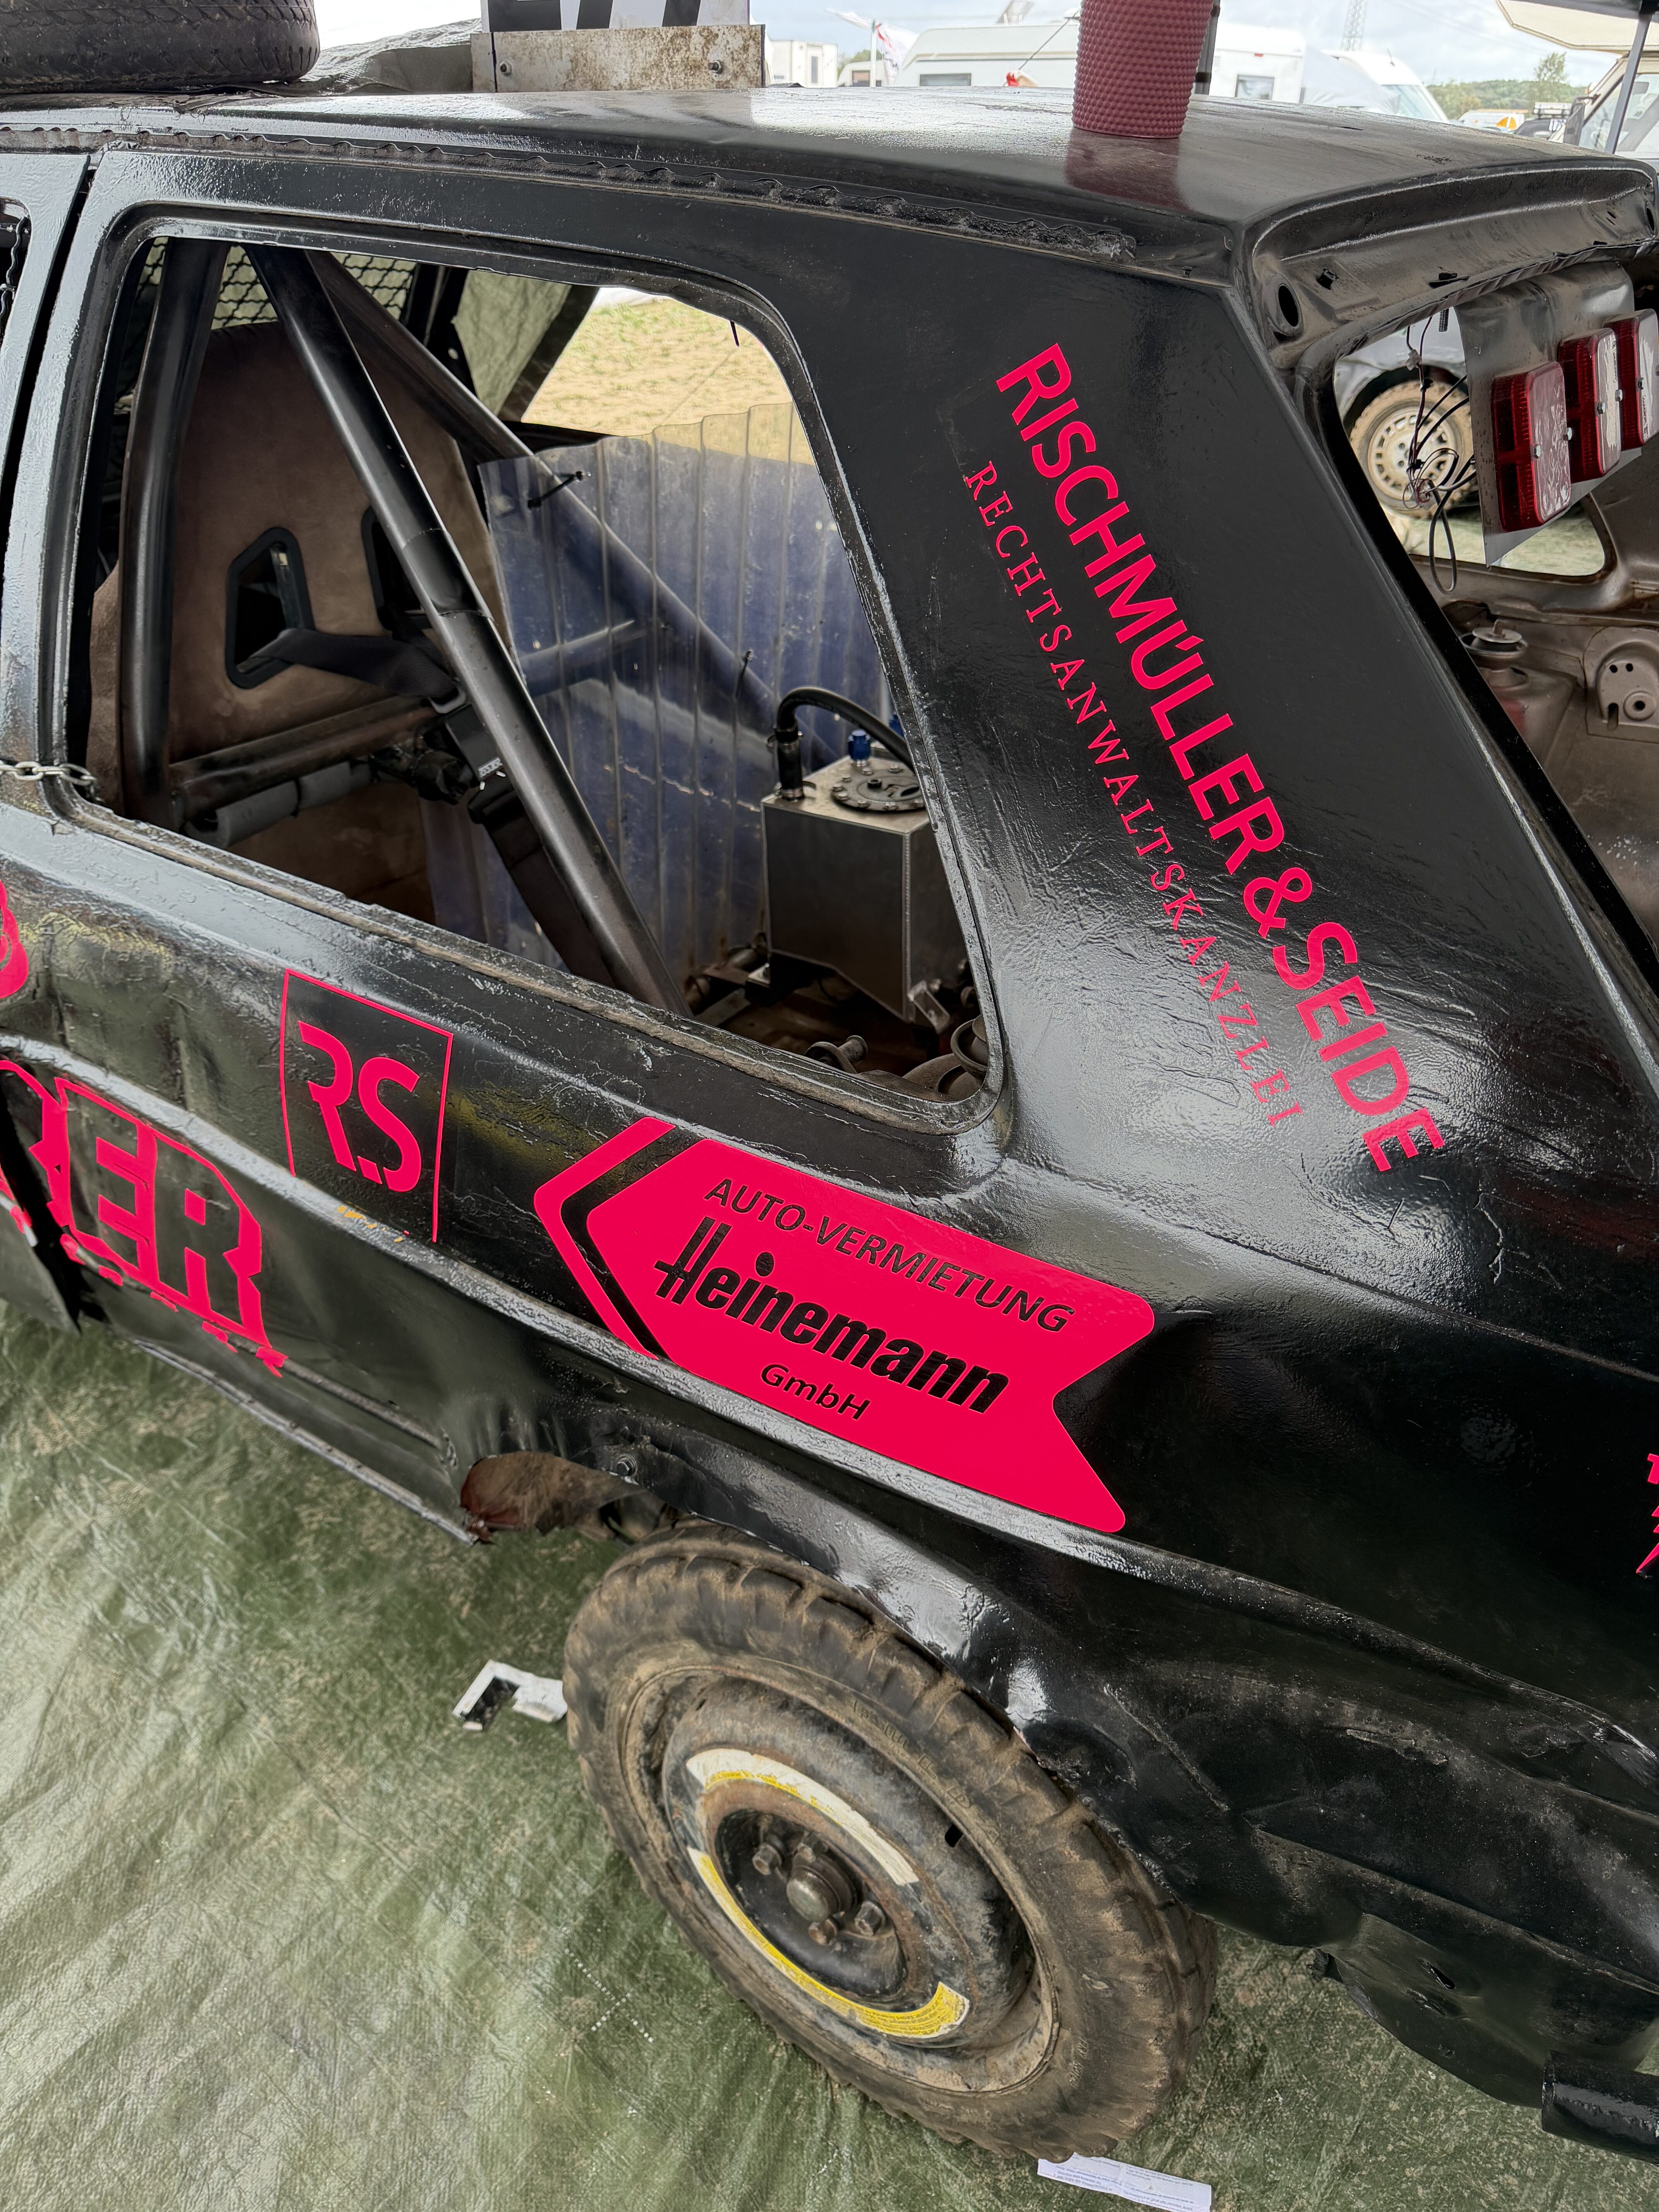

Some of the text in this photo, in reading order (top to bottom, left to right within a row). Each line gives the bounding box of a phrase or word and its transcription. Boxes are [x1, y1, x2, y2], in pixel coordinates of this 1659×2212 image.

[965, 462, 1302, 1126] RECHTSANWALTSKANZLEI
[654, 1217, 1009, 1413] Heinemann
[704, 1178, 1075, 1332] AUTO-VERMIETUNG
[762, 1365, 870, 1420] GmbH
